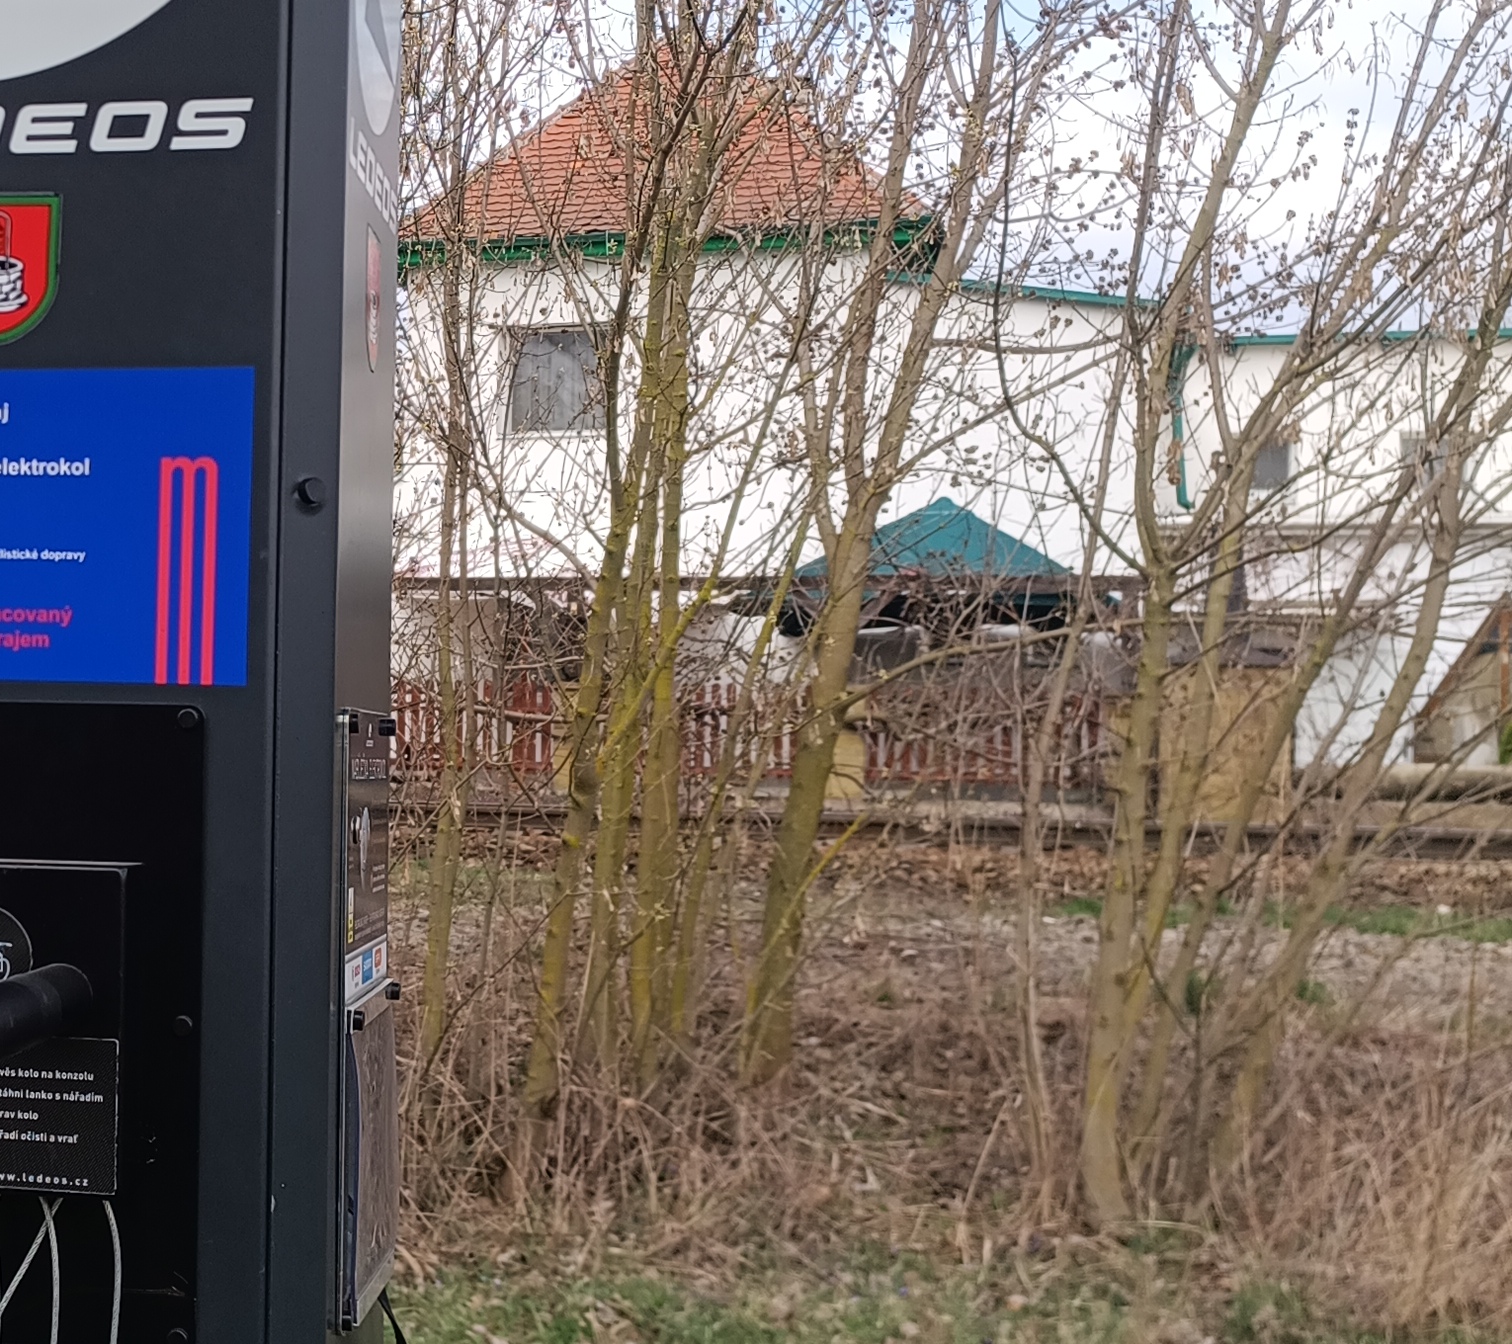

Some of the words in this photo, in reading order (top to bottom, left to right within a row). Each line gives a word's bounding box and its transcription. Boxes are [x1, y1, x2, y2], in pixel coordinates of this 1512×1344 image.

[349, 116, 398, 235] LEDEOS
[40, 549, 86, 562] dopravy
[18, 1068, 39, 1077] kolo
[41, 1070, 53, 1079] na
[55, 1070, 94, 1081] konzolu
[26, 1089, 53, 1100] lanko
[55, 1092, 61, 1100] s
[62, 1091, 103, 1102] nářadím
[17, 1110, 39, 1120] kolo
[21, 1131, 47, 1142] očisti
[49, 1134, 55, 1142] a
